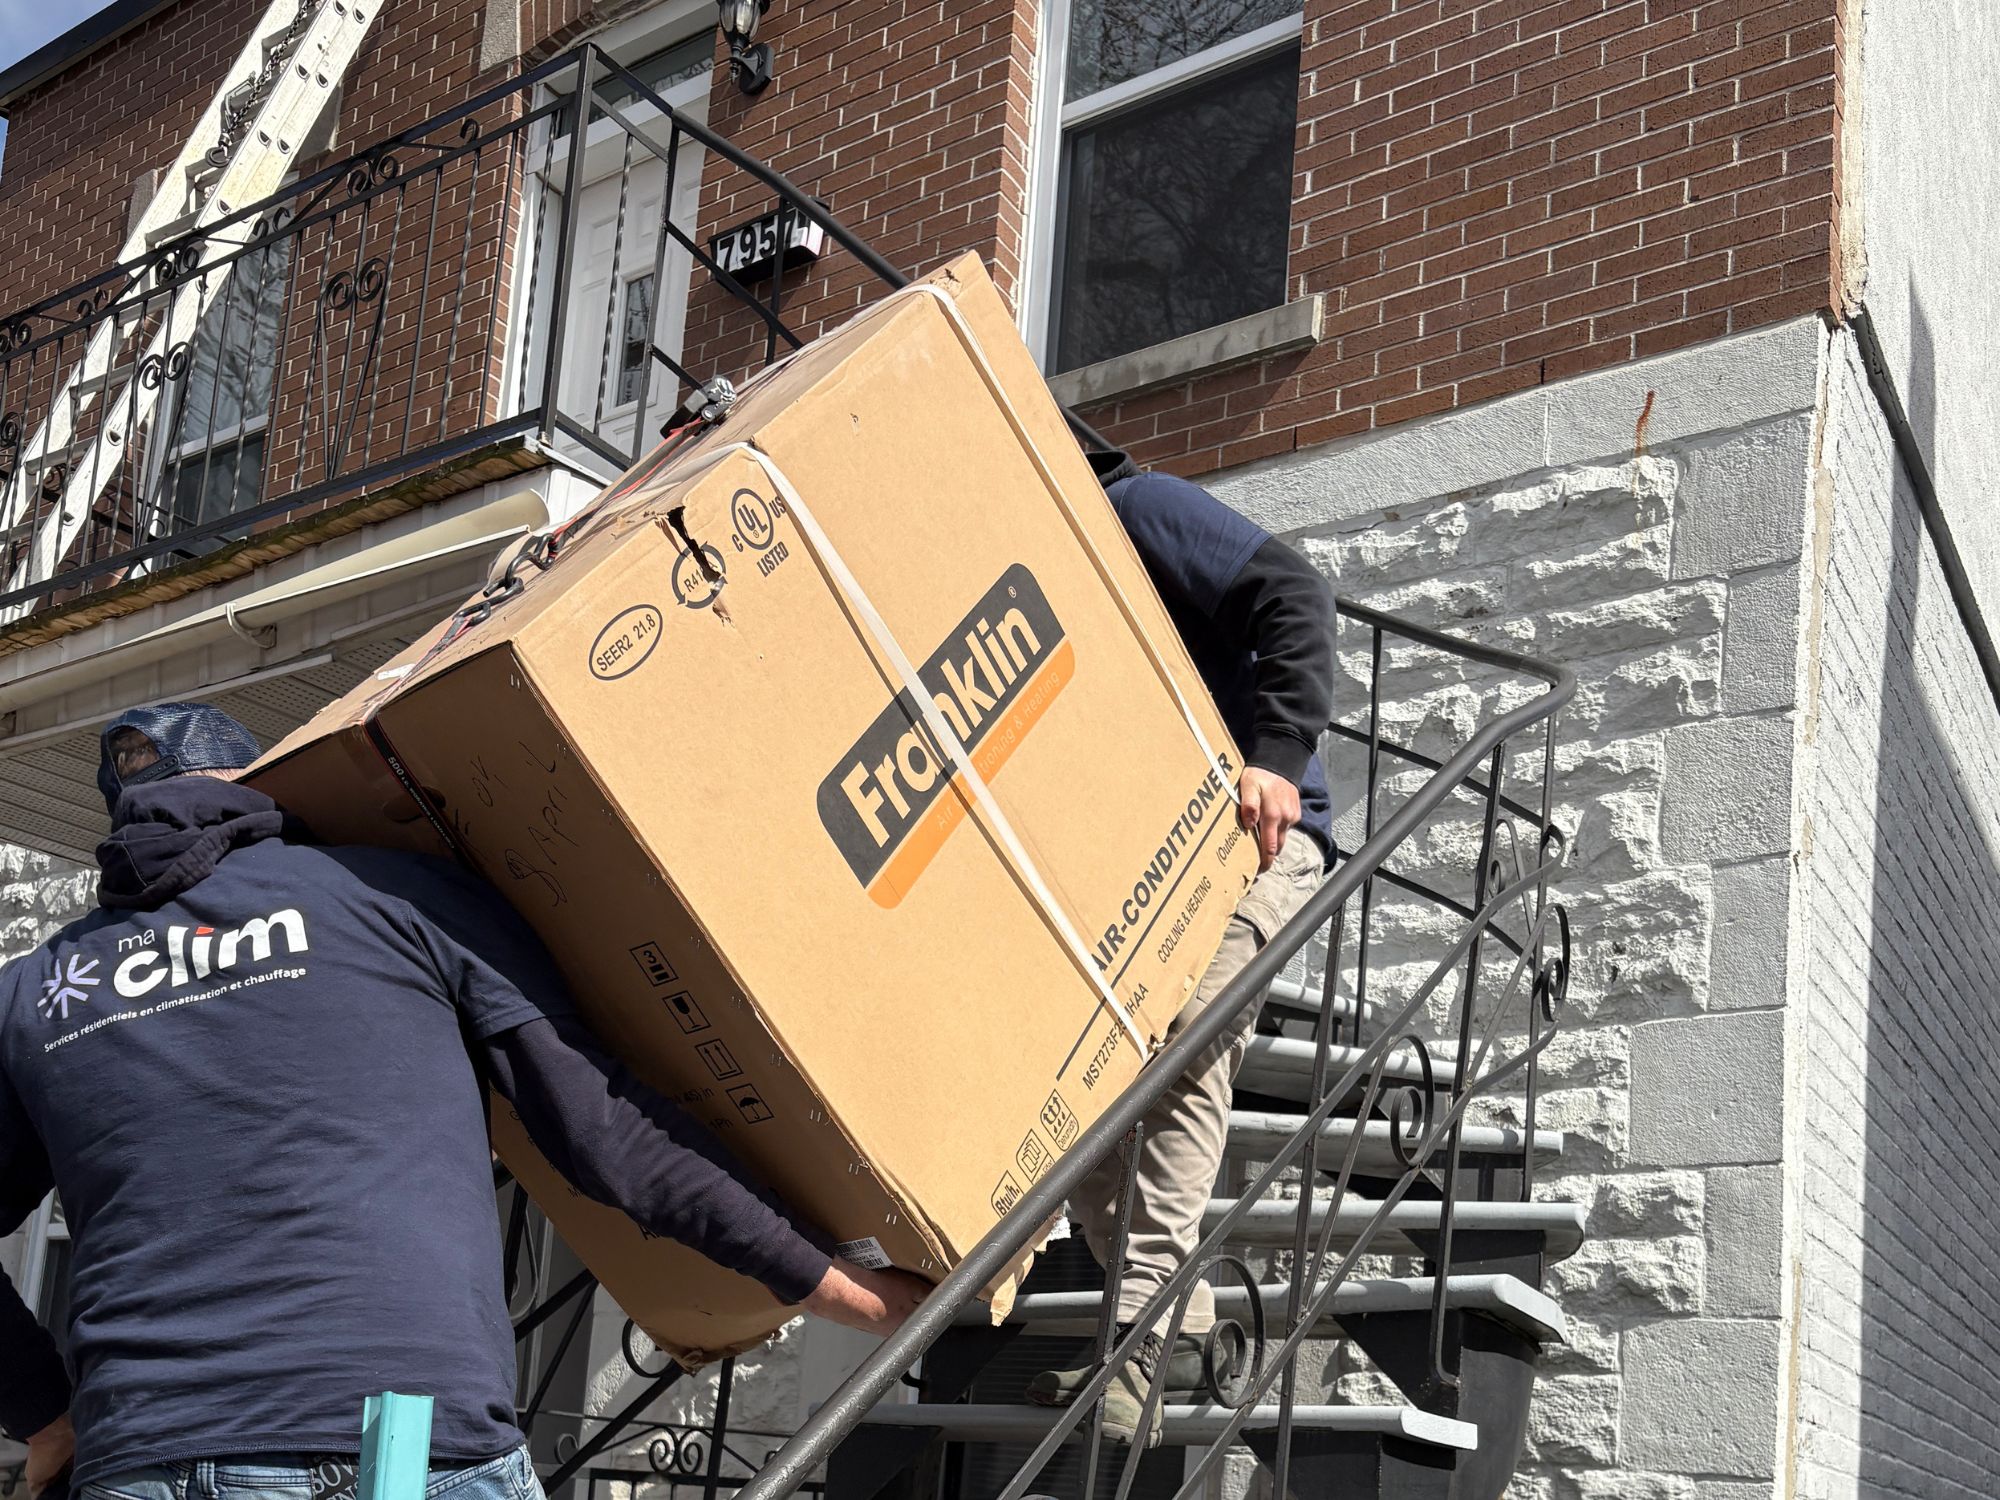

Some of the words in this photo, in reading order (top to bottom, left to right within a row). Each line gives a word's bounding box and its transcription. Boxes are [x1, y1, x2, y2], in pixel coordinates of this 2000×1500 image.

[737, 503, 768, 533] UL
[756, 541, 789, 578] LISTED
[596, 634, 634, 671] SEER2
[632, 613, 656, 640] 21.8
[840, 608, 1042, 848] Franklin
[1181, 911, 1191, 925] &
[1185, 876, 1212, 918] HEATING
[113, 908, 309, 998] clim
[118, 928, 155, 953] ma
[1158, 918, 1186, 963] COOLING
[44, 1031, 79, 1053] Services
[80, 1011, 138, 1036] résidentiels
[139, 1007, 154, 1017] en
[156, 986, 228, 1012] climatisation
[229, 981, 242, 991] et
[244, 968, 307, 986] chauffage
